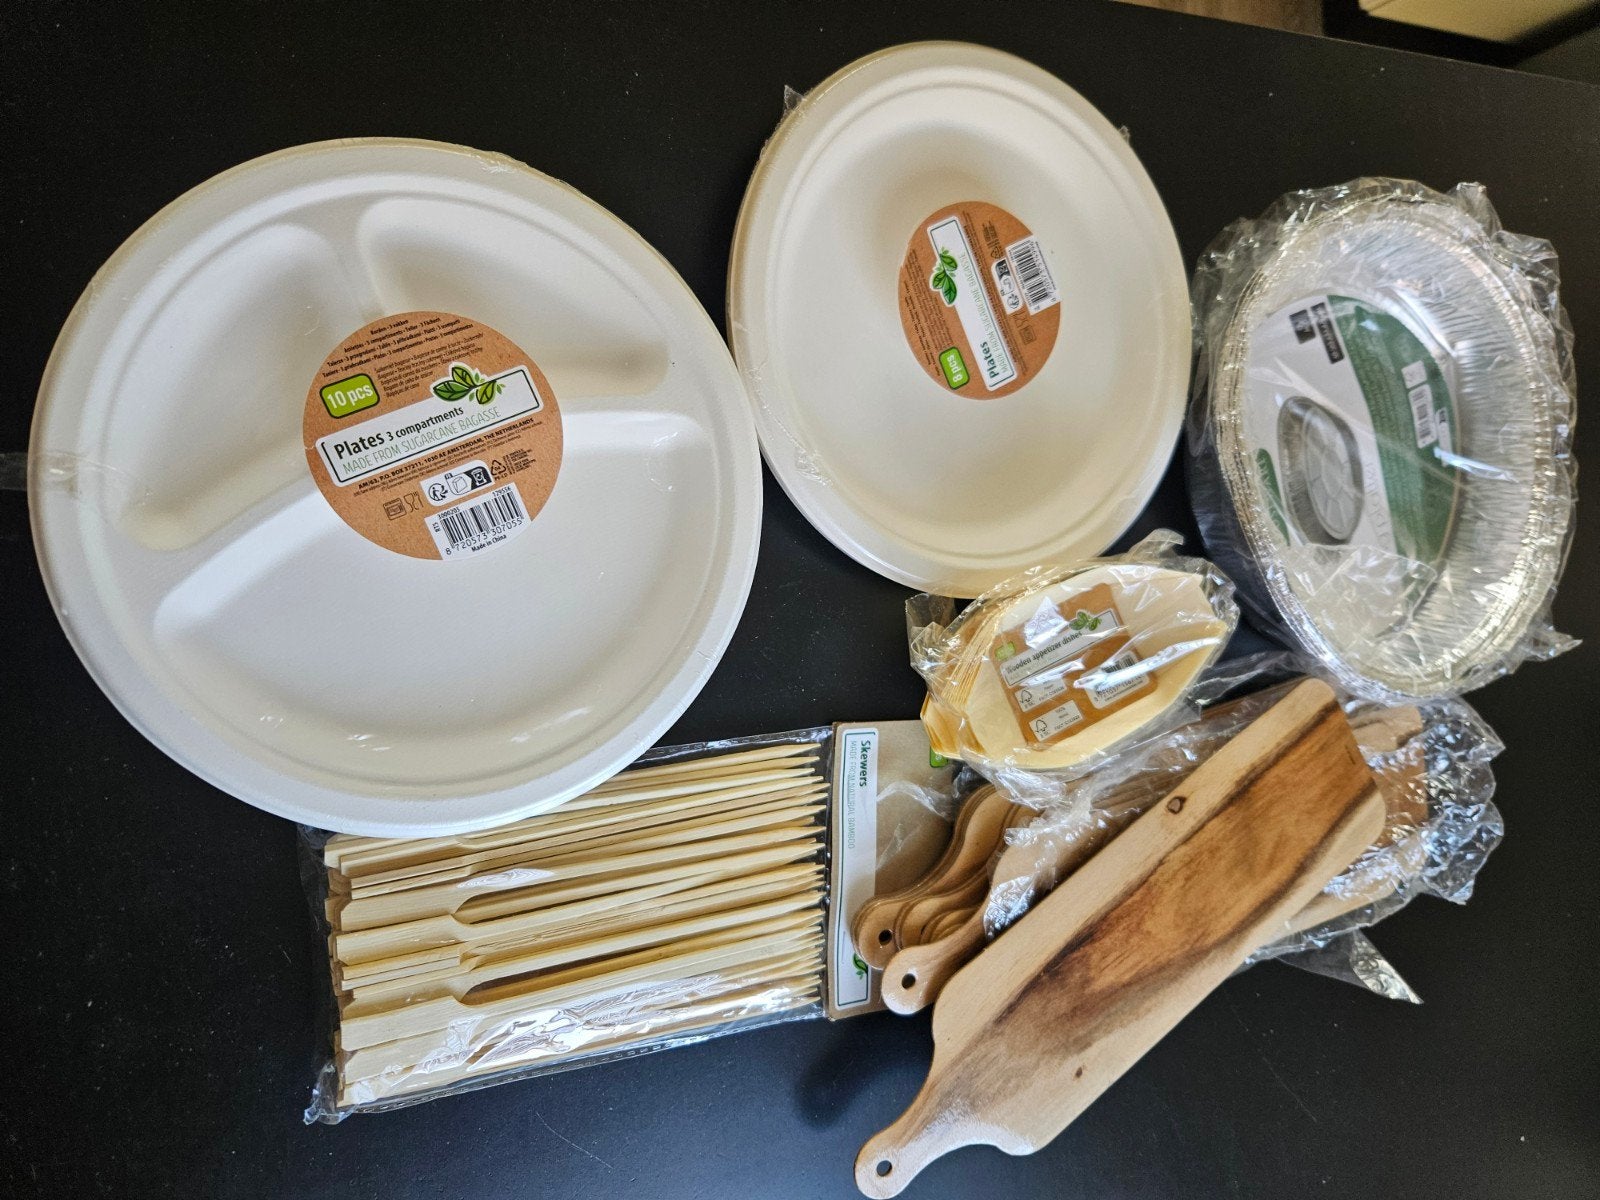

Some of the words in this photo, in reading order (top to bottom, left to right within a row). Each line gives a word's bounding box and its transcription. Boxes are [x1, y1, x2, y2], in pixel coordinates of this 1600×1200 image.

[987, 331, 1000, 352] FROM
[947, 354, 961, 373] pcs
[981, 342, 999, 378] Plates
[995, 353, 1008, 373] MADE
[953, 374, 962, 382] 8
[328, 391, 346, 408] 10
[347, 385, 373, 405] pcs
[334, 433, 384, 459] Plates
[386, 431, 394, 441] 3
[396, 408, 463, 437] compartments
[342, 455, 372, 474] MADE
[372, 444, 401, 462] FROM
[401, 422, 458, 452] SUGARCANE
[458, 406, 500, 430] BAGASSE
[391, 468, 404, 476] BOX
[424, 455, 438, 463] 1030
[447, 438, 484, 454] AMSTERDAM,
[483, 432, 495, 440] THE
[495, 418, 533, 436] NETHERLANDS
[444, 546, 452, 555] 8
[455, 532, 488, 551] 720573
[489, 517, 523, 536] 307055
[471, 543, 486, 552] Made
[492, 534, 506, 543] China
[1030, 640, 1063, 663] appetizer
[849, 740, 857, 759] MADE
[847, 761, 856, 781] FROM
[859, 740, 870, 786] Skewers
[846, 782, 856, 815] NATURAL
[846, 817, 856, 849] BAMBOO
